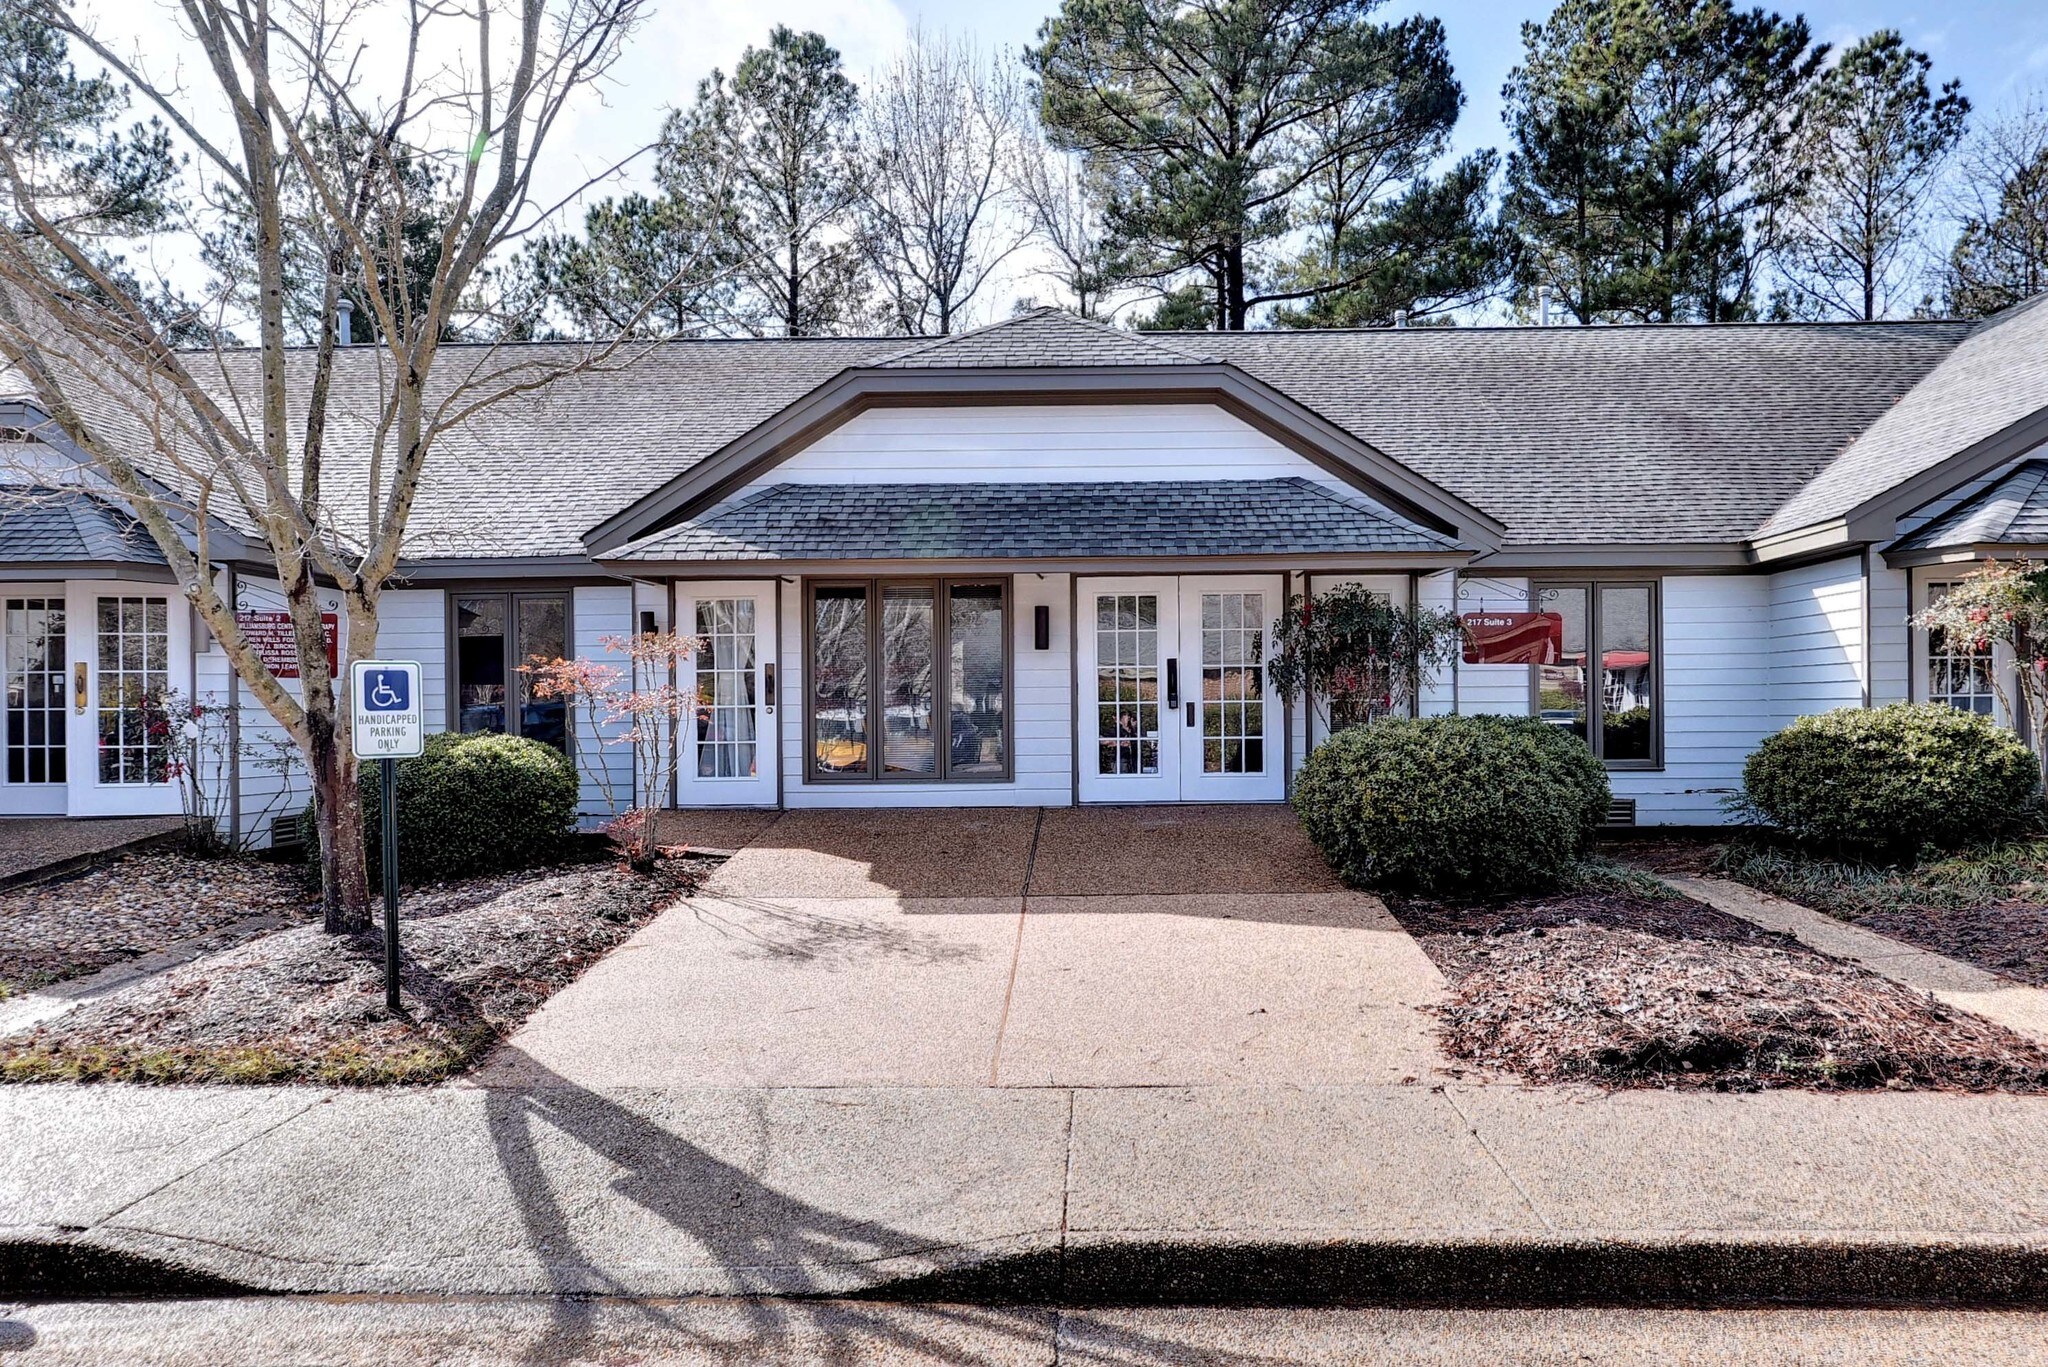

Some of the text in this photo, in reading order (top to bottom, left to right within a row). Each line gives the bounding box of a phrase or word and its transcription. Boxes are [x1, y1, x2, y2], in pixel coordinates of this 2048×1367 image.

[1467, 618, 1512, 626] 217 Suite 3
[358, 715, 417, 724] HANDICAPPED
[370, 727, 406, 736] PARKING
[378, 739, 399, 749] ONLY
